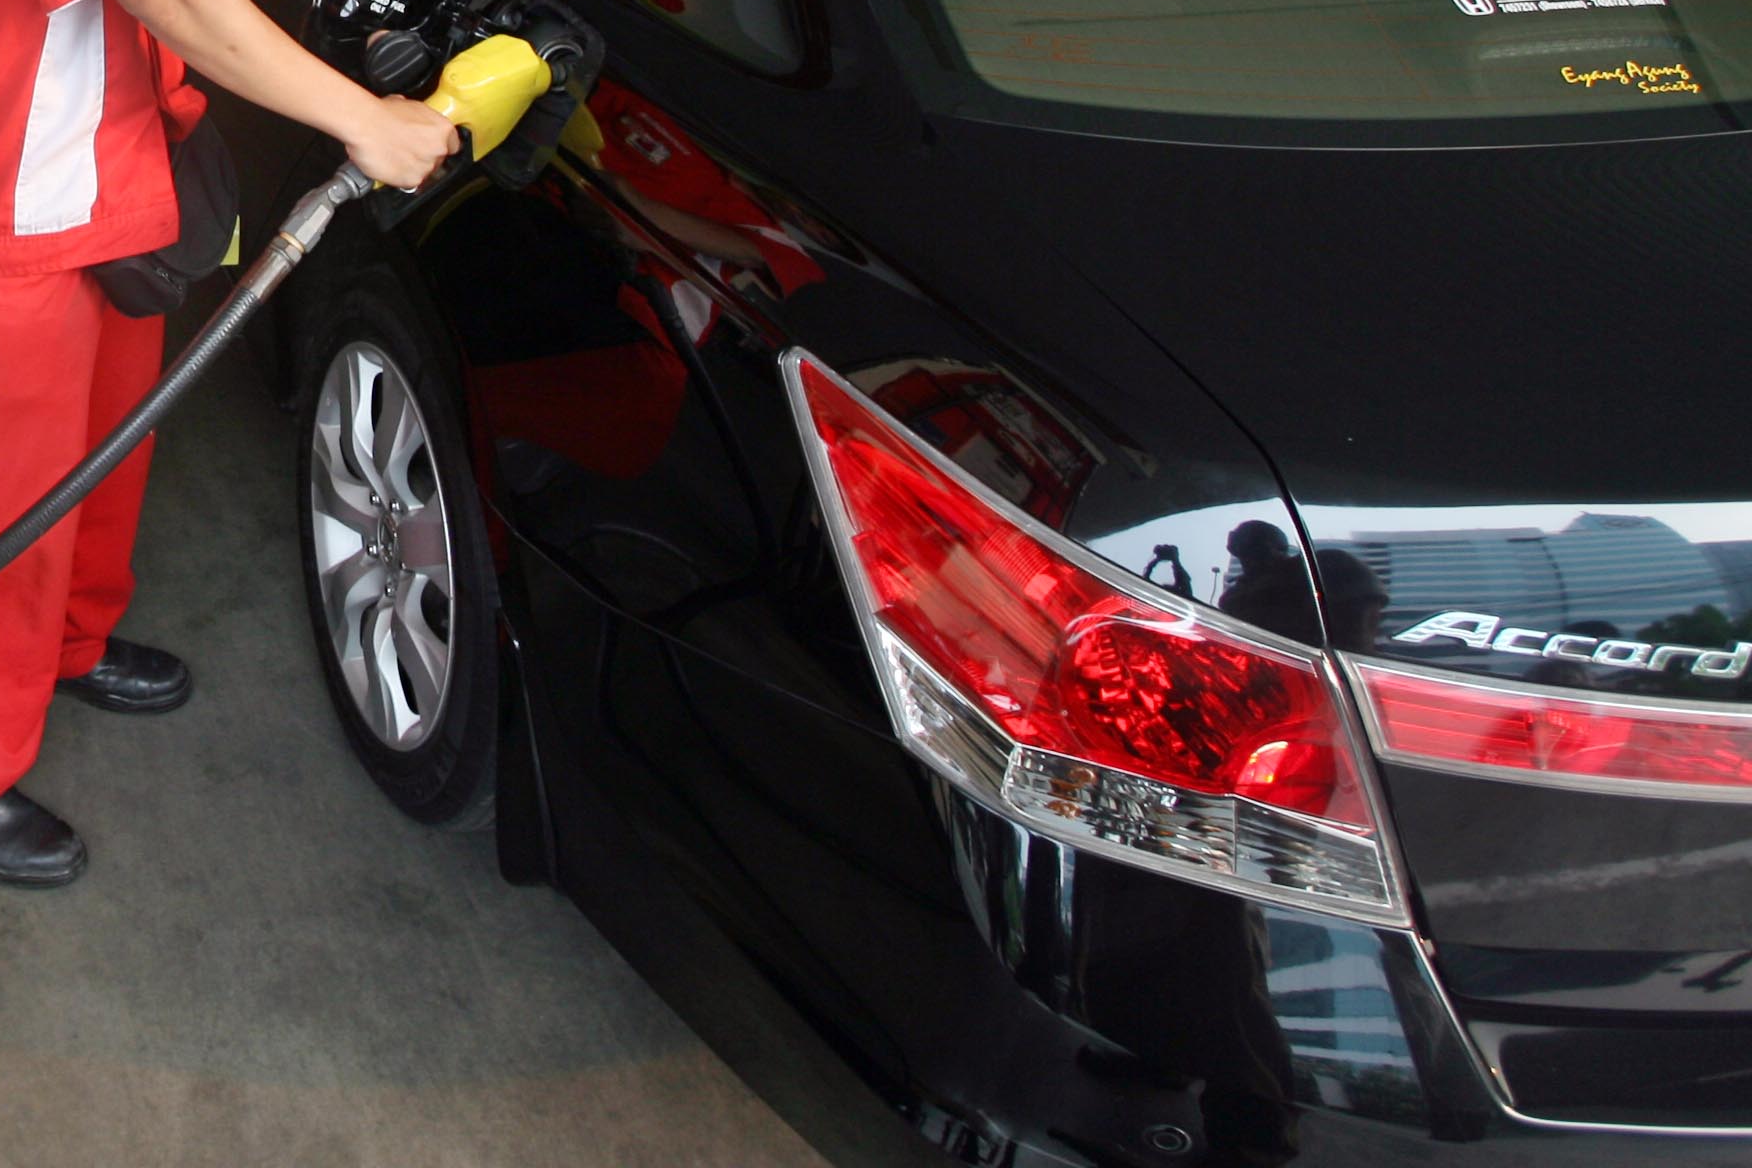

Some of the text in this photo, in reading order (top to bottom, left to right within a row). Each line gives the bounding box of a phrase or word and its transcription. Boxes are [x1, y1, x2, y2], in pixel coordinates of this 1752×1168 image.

[1560, 60, 1691, 88] Eyang Agung
[1637, 80, 1701, 94] Society
[1391, 610, 1752, 680] Accord
